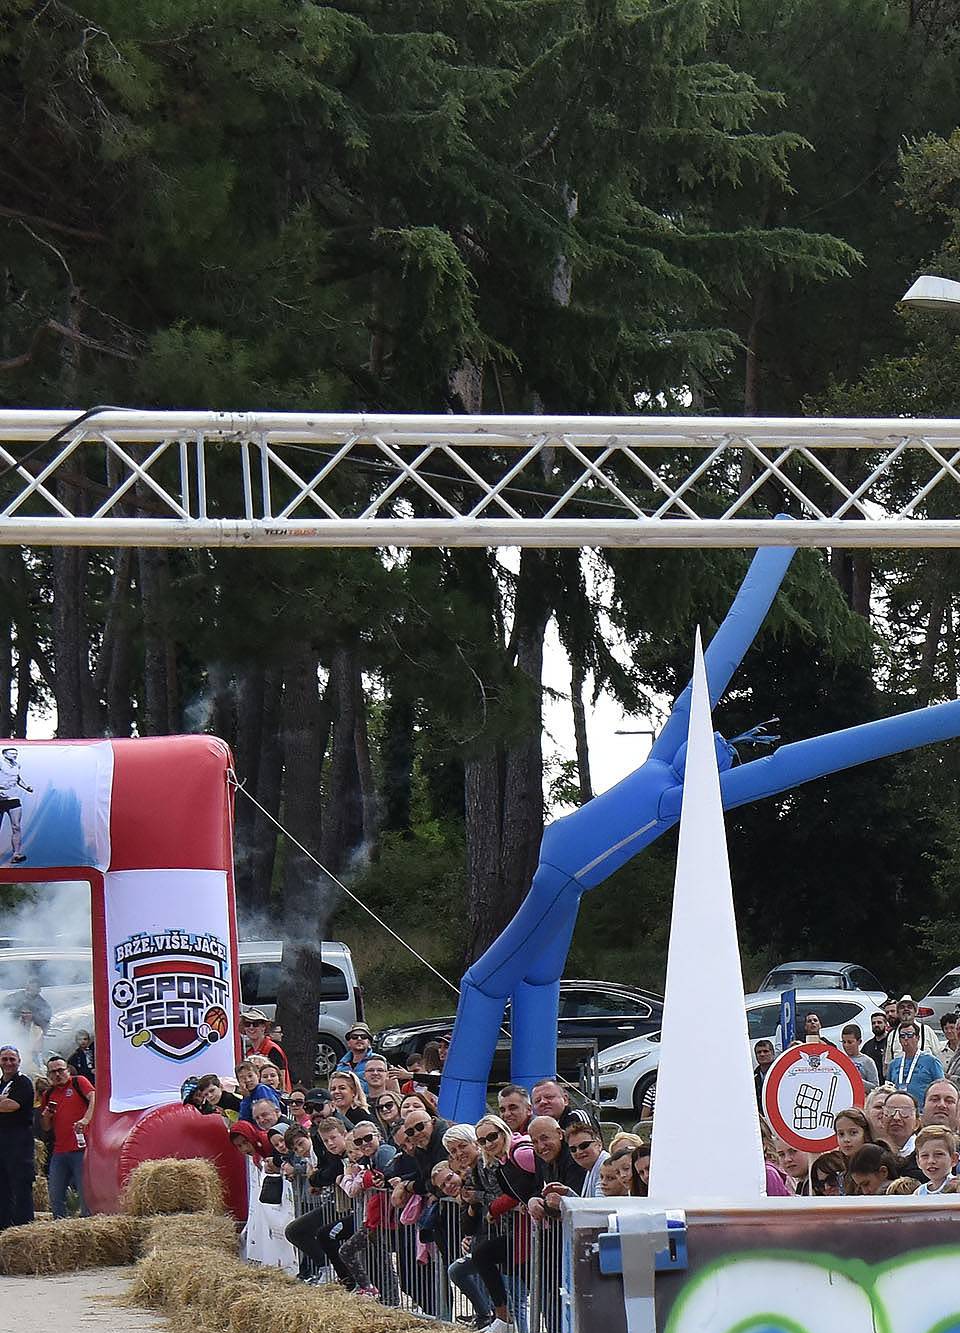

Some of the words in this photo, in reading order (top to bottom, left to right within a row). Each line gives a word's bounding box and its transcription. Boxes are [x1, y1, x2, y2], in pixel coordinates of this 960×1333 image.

[116, 936, 154, 962] BRŽE,
[153, 930, 193, 952] VIŠE,
[135, 974, 228, 1006] SPORT
[118, 1000, 205, 1038] FEST
[784, 1002, 791, 1040] P
